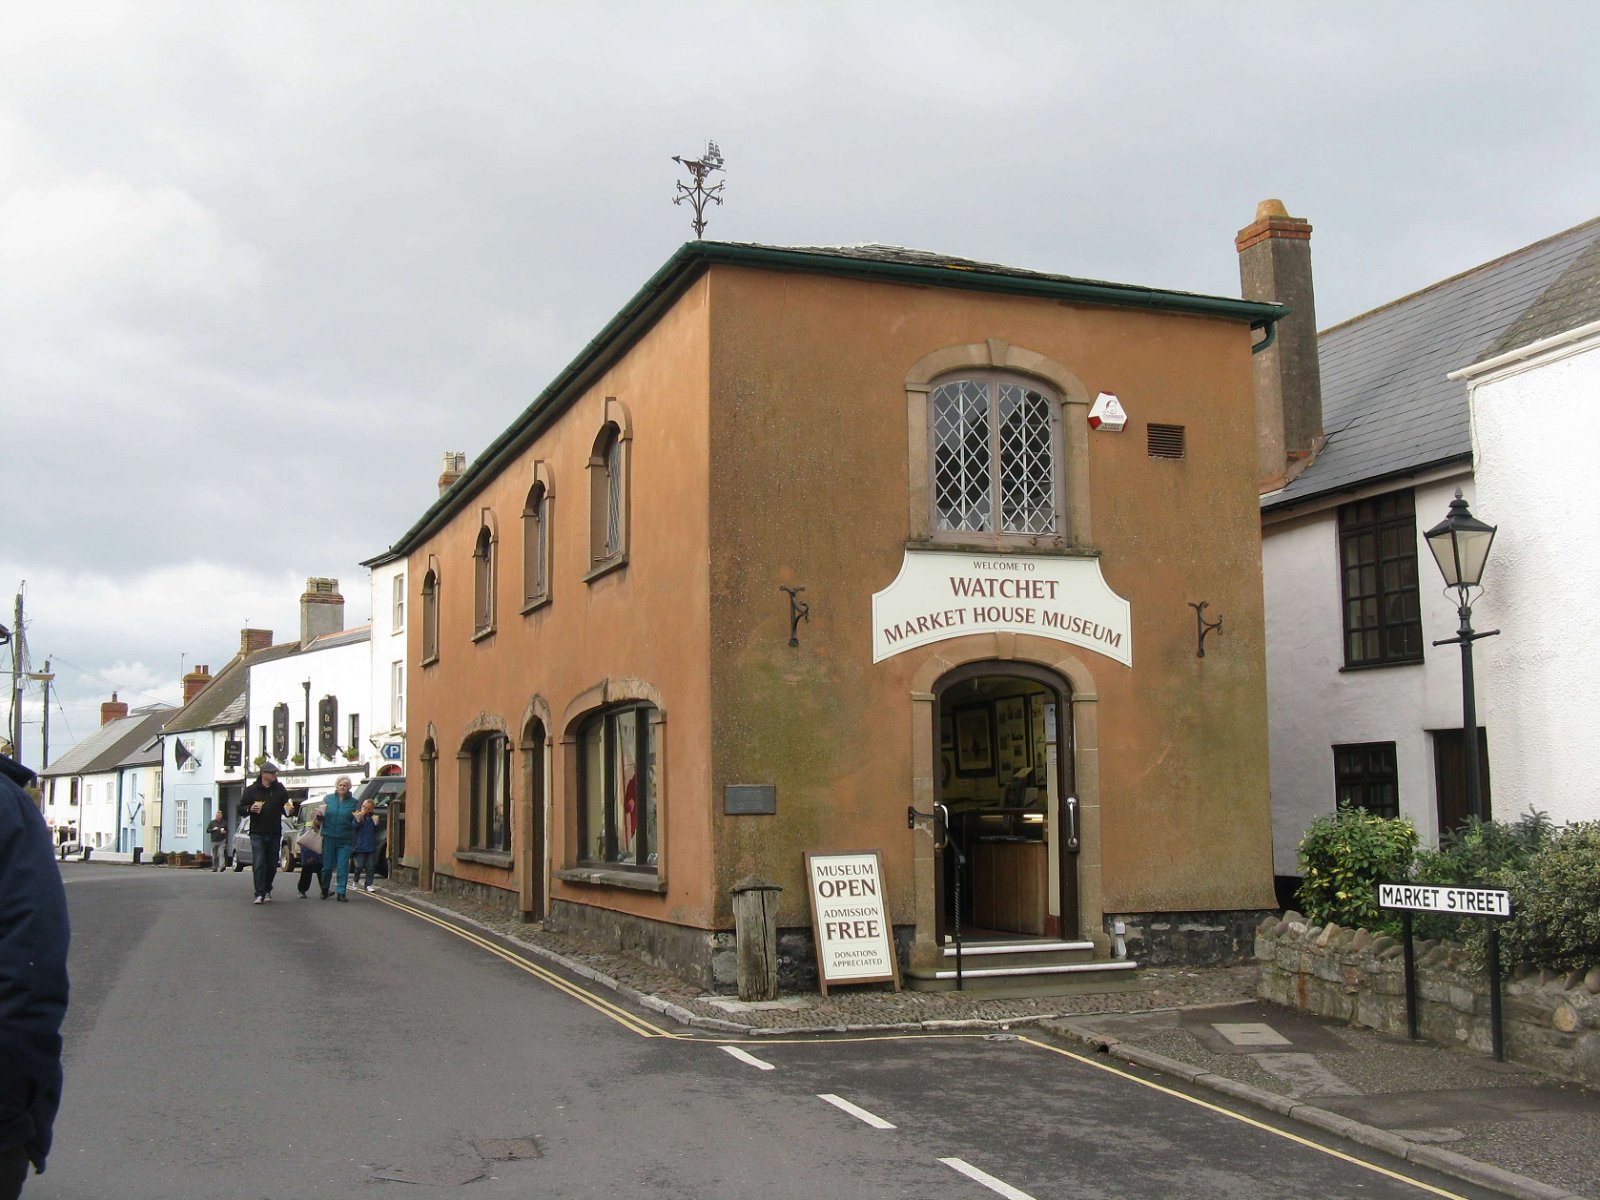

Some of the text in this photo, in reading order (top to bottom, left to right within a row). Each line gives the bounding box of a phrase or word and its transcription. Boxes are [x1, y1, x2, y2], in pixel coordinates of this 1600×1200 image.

[973, 560, 1035, 571] WELCOME TO
[950, 576, 1059, 600] WATCHET
[884, 606, 1122, 648] MARKET HOUSE MUSEUM
[390, 745, 399, 758] P
[816, 864, 874, 877] MUSEUM
[818, 879, 876, 898] OPEN
[1382, 886, 1505, 912] MARKET STREET
[823, 907, 878, 918] ADMISSION
[826, 920, 880, 940] FREE
[834, 949, 878, 959] DONATIONS
[832, 958, 883, 968] APPRECIATED
